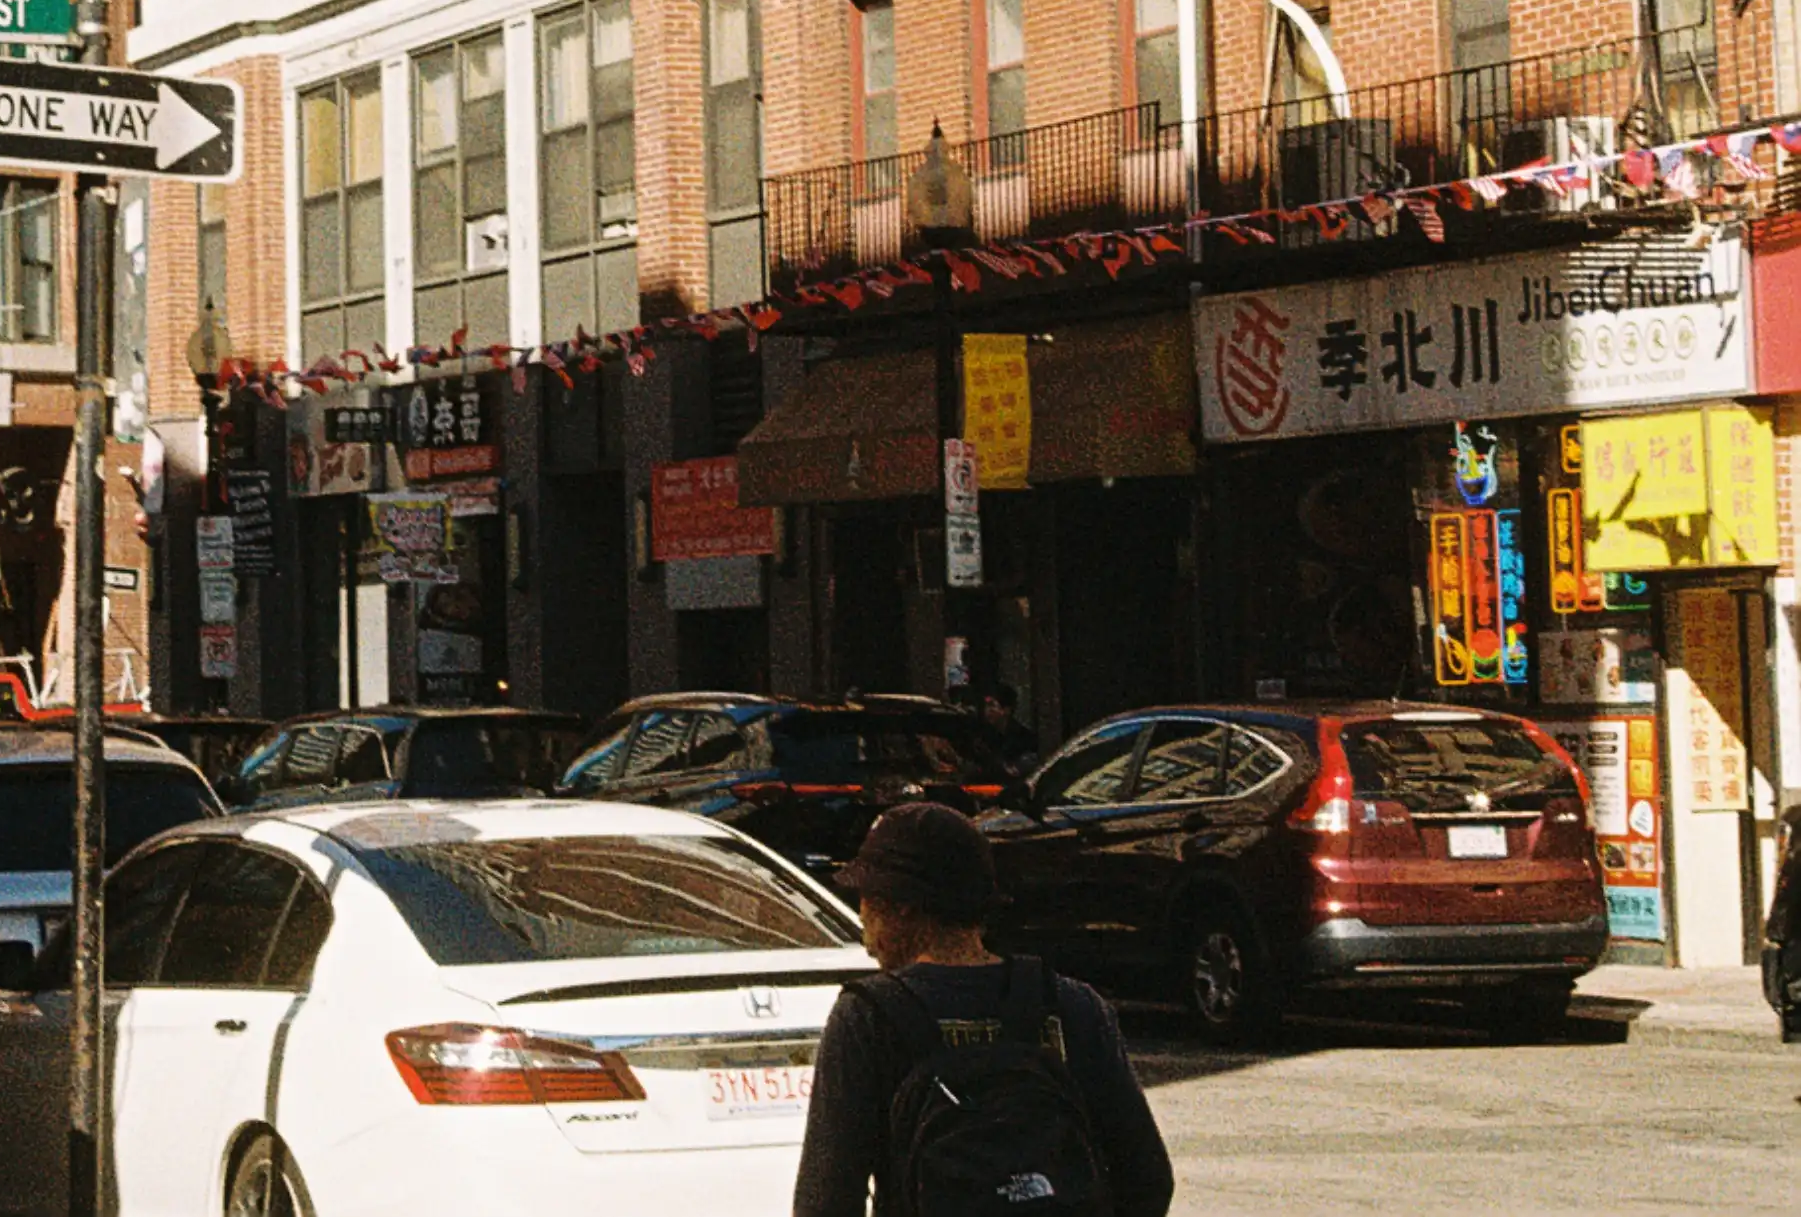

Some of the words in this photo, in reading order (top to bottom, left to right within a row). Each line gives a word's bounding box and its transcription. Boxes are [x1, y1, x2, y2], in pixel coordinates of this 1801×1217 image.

[88, 100, 158, 142] WAY
[1517, 263, 1716, 325] JibeiChuan
[1316, 297, 1500, 402] 季北川
